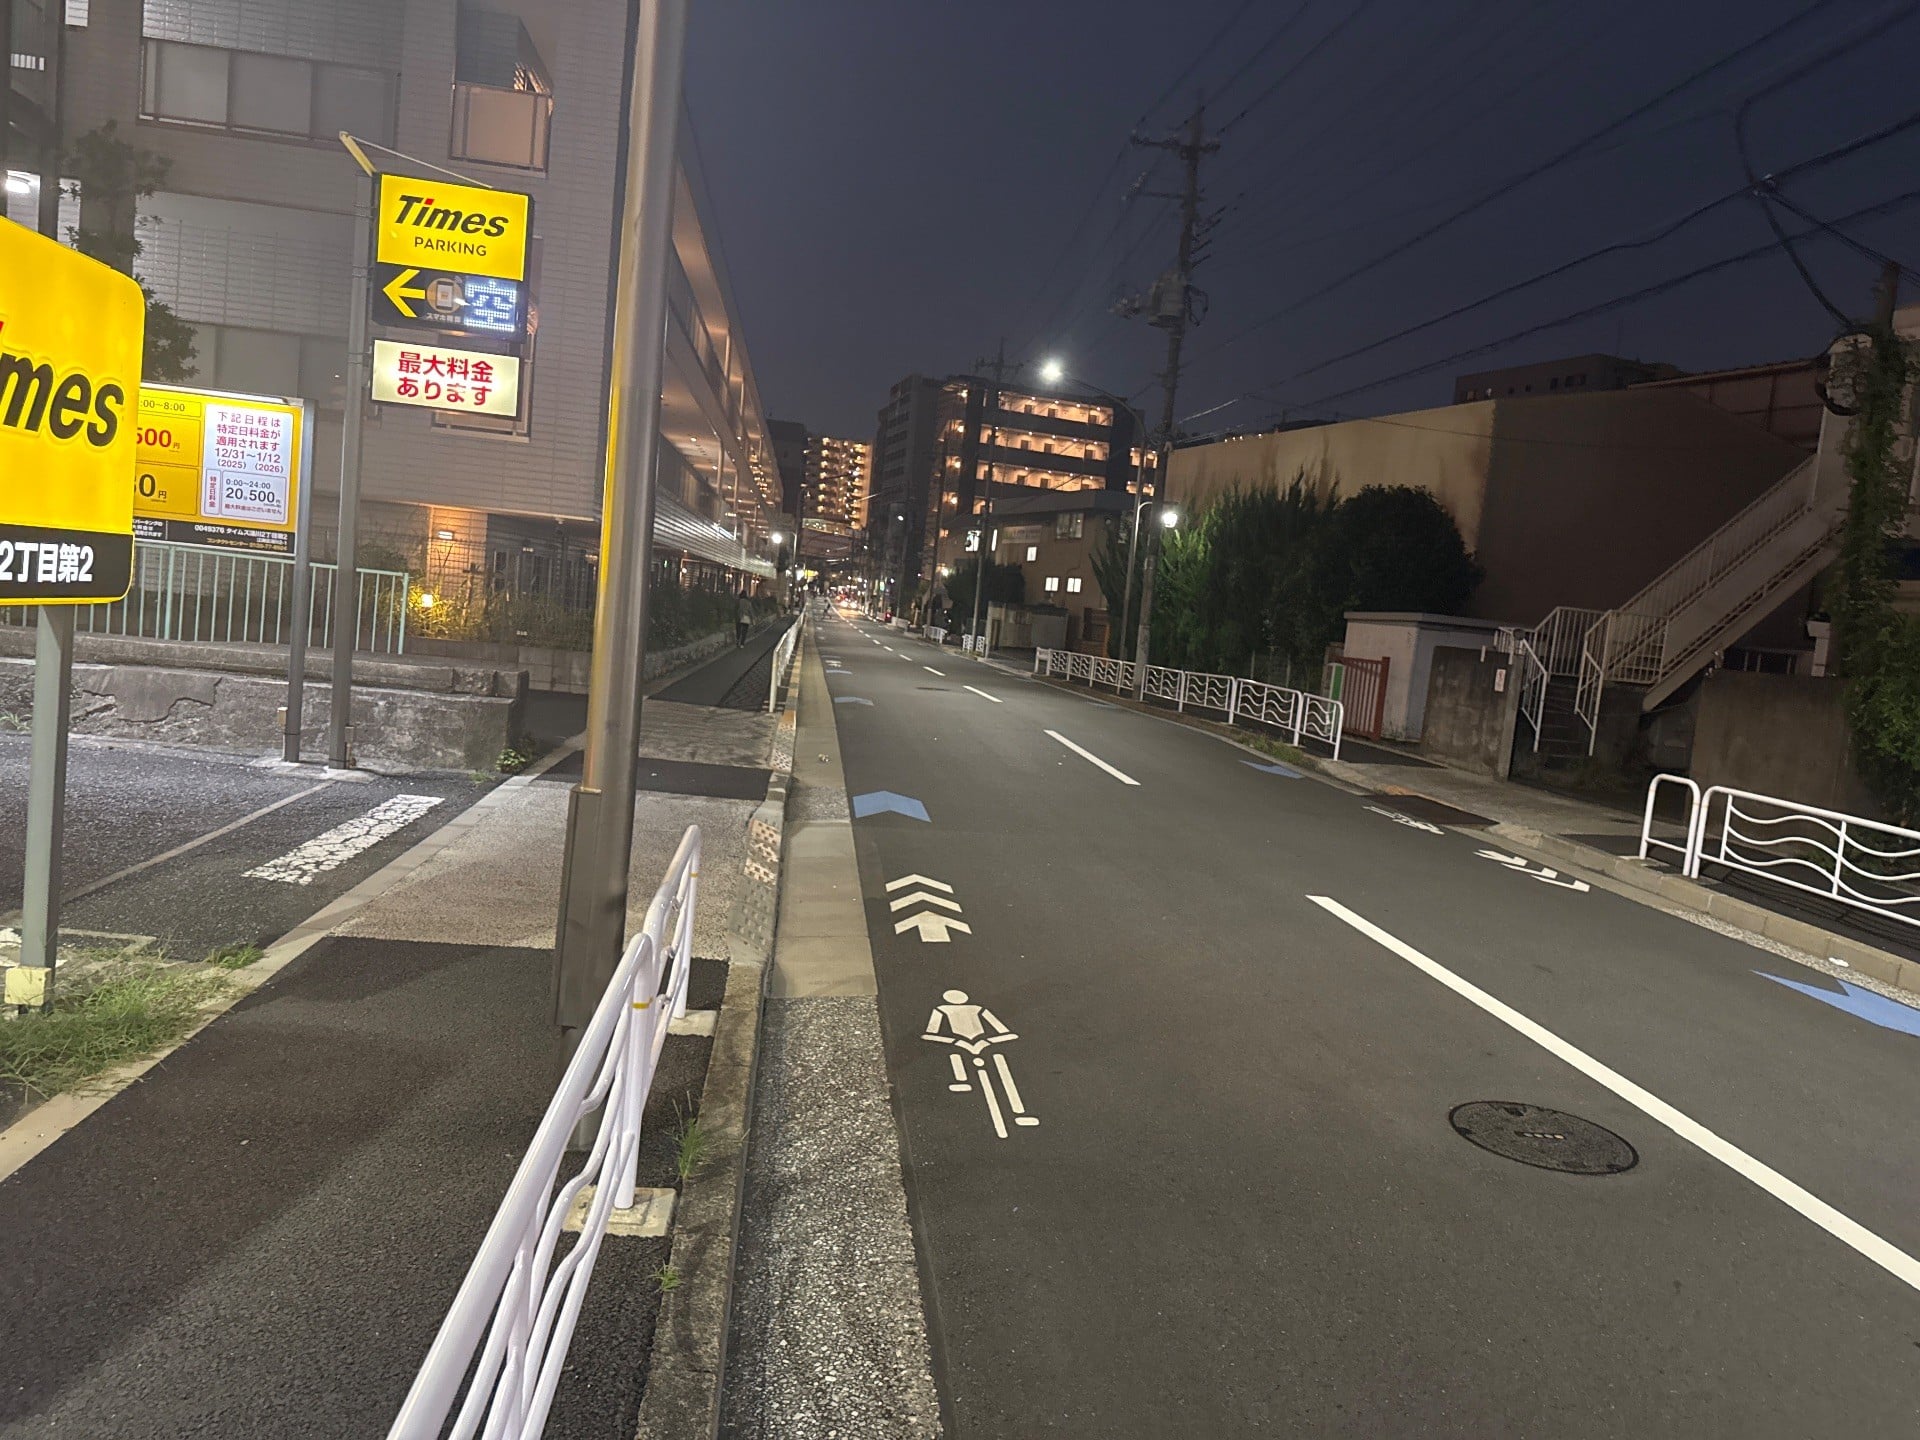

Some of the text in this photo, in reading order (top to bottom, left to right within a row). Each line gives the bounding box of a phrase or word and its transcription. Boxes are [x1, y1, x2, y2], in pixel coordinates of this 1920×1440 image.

[395, 194, 509, 237] Times
[414, 236, 487, 256] PARKING
[465, 280, 517, 331] 空
[398, 351, 493, 383] 最大料金
[0, 321, 124, 447] mes
[397, 377, 492, 405] あります
[217, 424, 280, 439] 特定日料金が
[218, 411, 281, 427] 下記日程は
[216, 436, 280, 451] 適用されます
[134, 473, 166, 499] 0円
[0, 540, 94, 583] 2丁目第2
